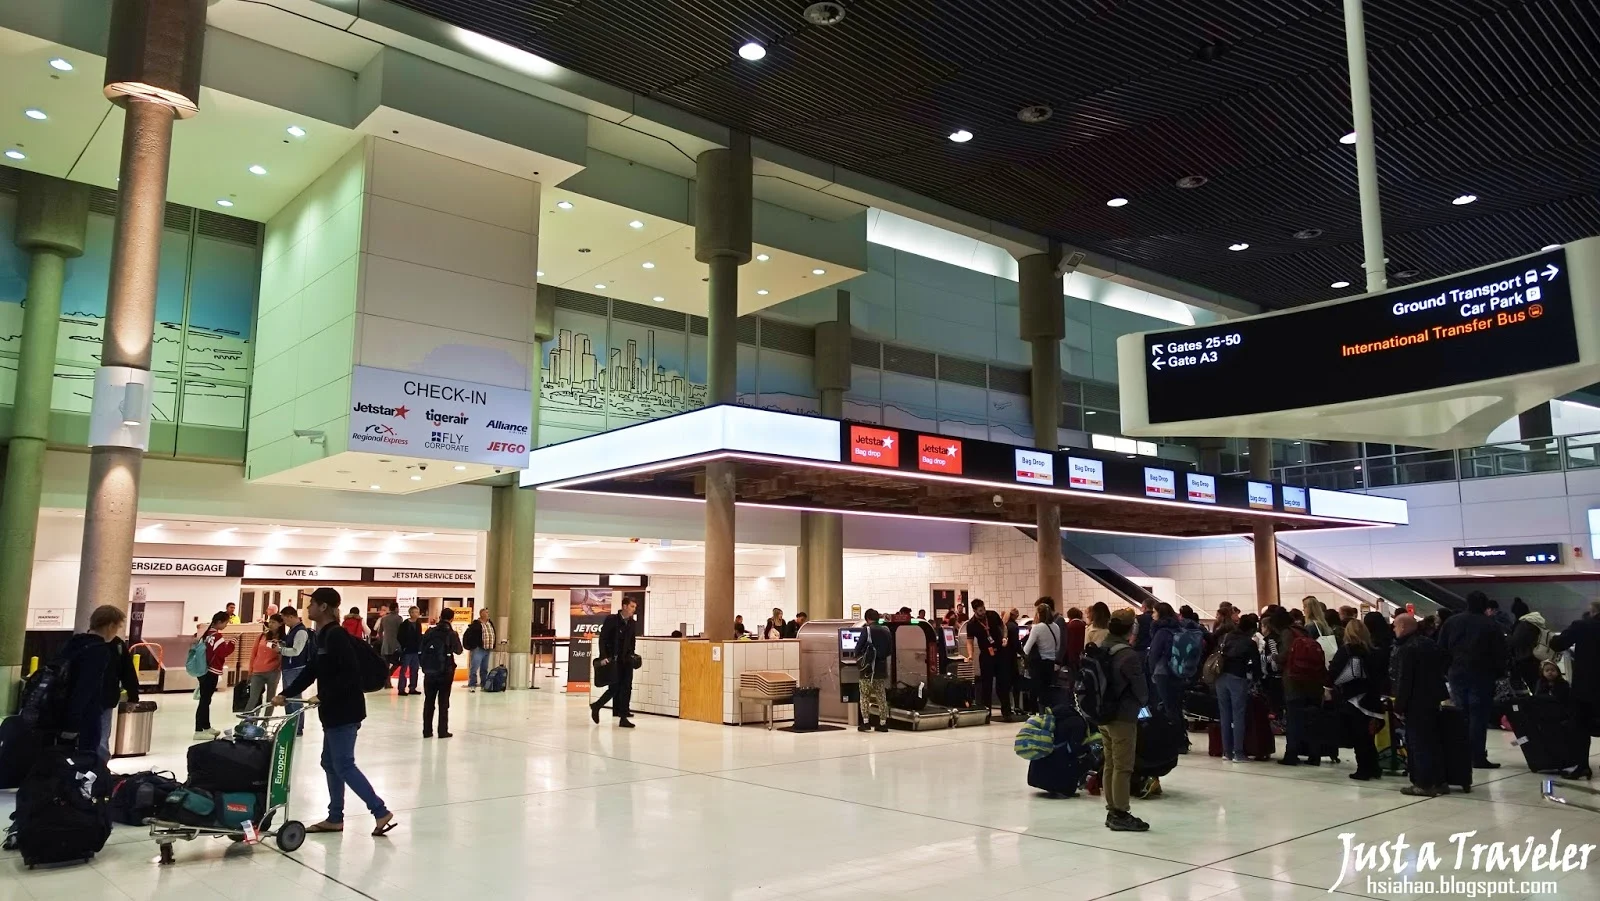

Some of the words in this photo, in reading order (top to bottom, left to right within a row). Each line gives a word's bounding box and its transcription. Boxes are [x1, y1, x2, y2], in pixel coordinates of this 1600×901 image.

[1393, 293, 1446, 316] Ground
[1449, 275, 1521, 303] Transport
[1460, 303, 1486, 317] Car
[1490, 292, 1523, 311] Park
[1342, 330, 1429, 356] International
[1432, 316, 1493, 340] Transfer
[1498, 310, 1525, 326] Bus
[1167, 341, 1202, 353] Gates
[1206, 334, 1241, 349] 25-50
[1168, 356, 1197, 367] Gate
[1200, 352, 1218, 363] A3
[403, 380, 487, 406] CHECK-IN
[353, 402, 396, 416] Jetstar
[425, 409, 469, 427] tigerair
[486, 419, 528, 433] Alliance
[352, 433, 383, 443] Regional
[383, 436, 408, 446] Express
[442, 433, 464, 444] FLY
[856, 435, 884, 447] Jetstar
[424, 442, 469, 452] CORPORATE
[487, 442, 526, 454] JETGO
[854, 447, 866, 456] Bag
[868, 449, 881, 458] drop
[922, 444, 948, 455] Jetstar
[922, 456, 933, 465] Bag
[934, 457, 946, 466] drop
[1021, 456, 1032, 465] Bag
[1032, 458, 1045, 467] Drop
[1074, 464, 1083, 472] Bag
[1084, 465, 1095, 474] Drop
[1149, 474, 1158, 482] Bag
[1158, 475, 1168, 483] Drop
[1191, 479, 1199, 487] Bag
[1199, 480, 1209, 488] Drop
[1249, 494, 1257, 503] bag
[1258, 495, 1267, 503] drop
[1284, 499, 1292, 507] bag
[131, 562, 172, 571] ERSIZED
[175, 563, 224, 572] BAGGAGE
[391, 571, 423, 579] JETSTAR
[424, 572, 453, 580] SERVICE
[275, 745, 286, 784] Europcar
